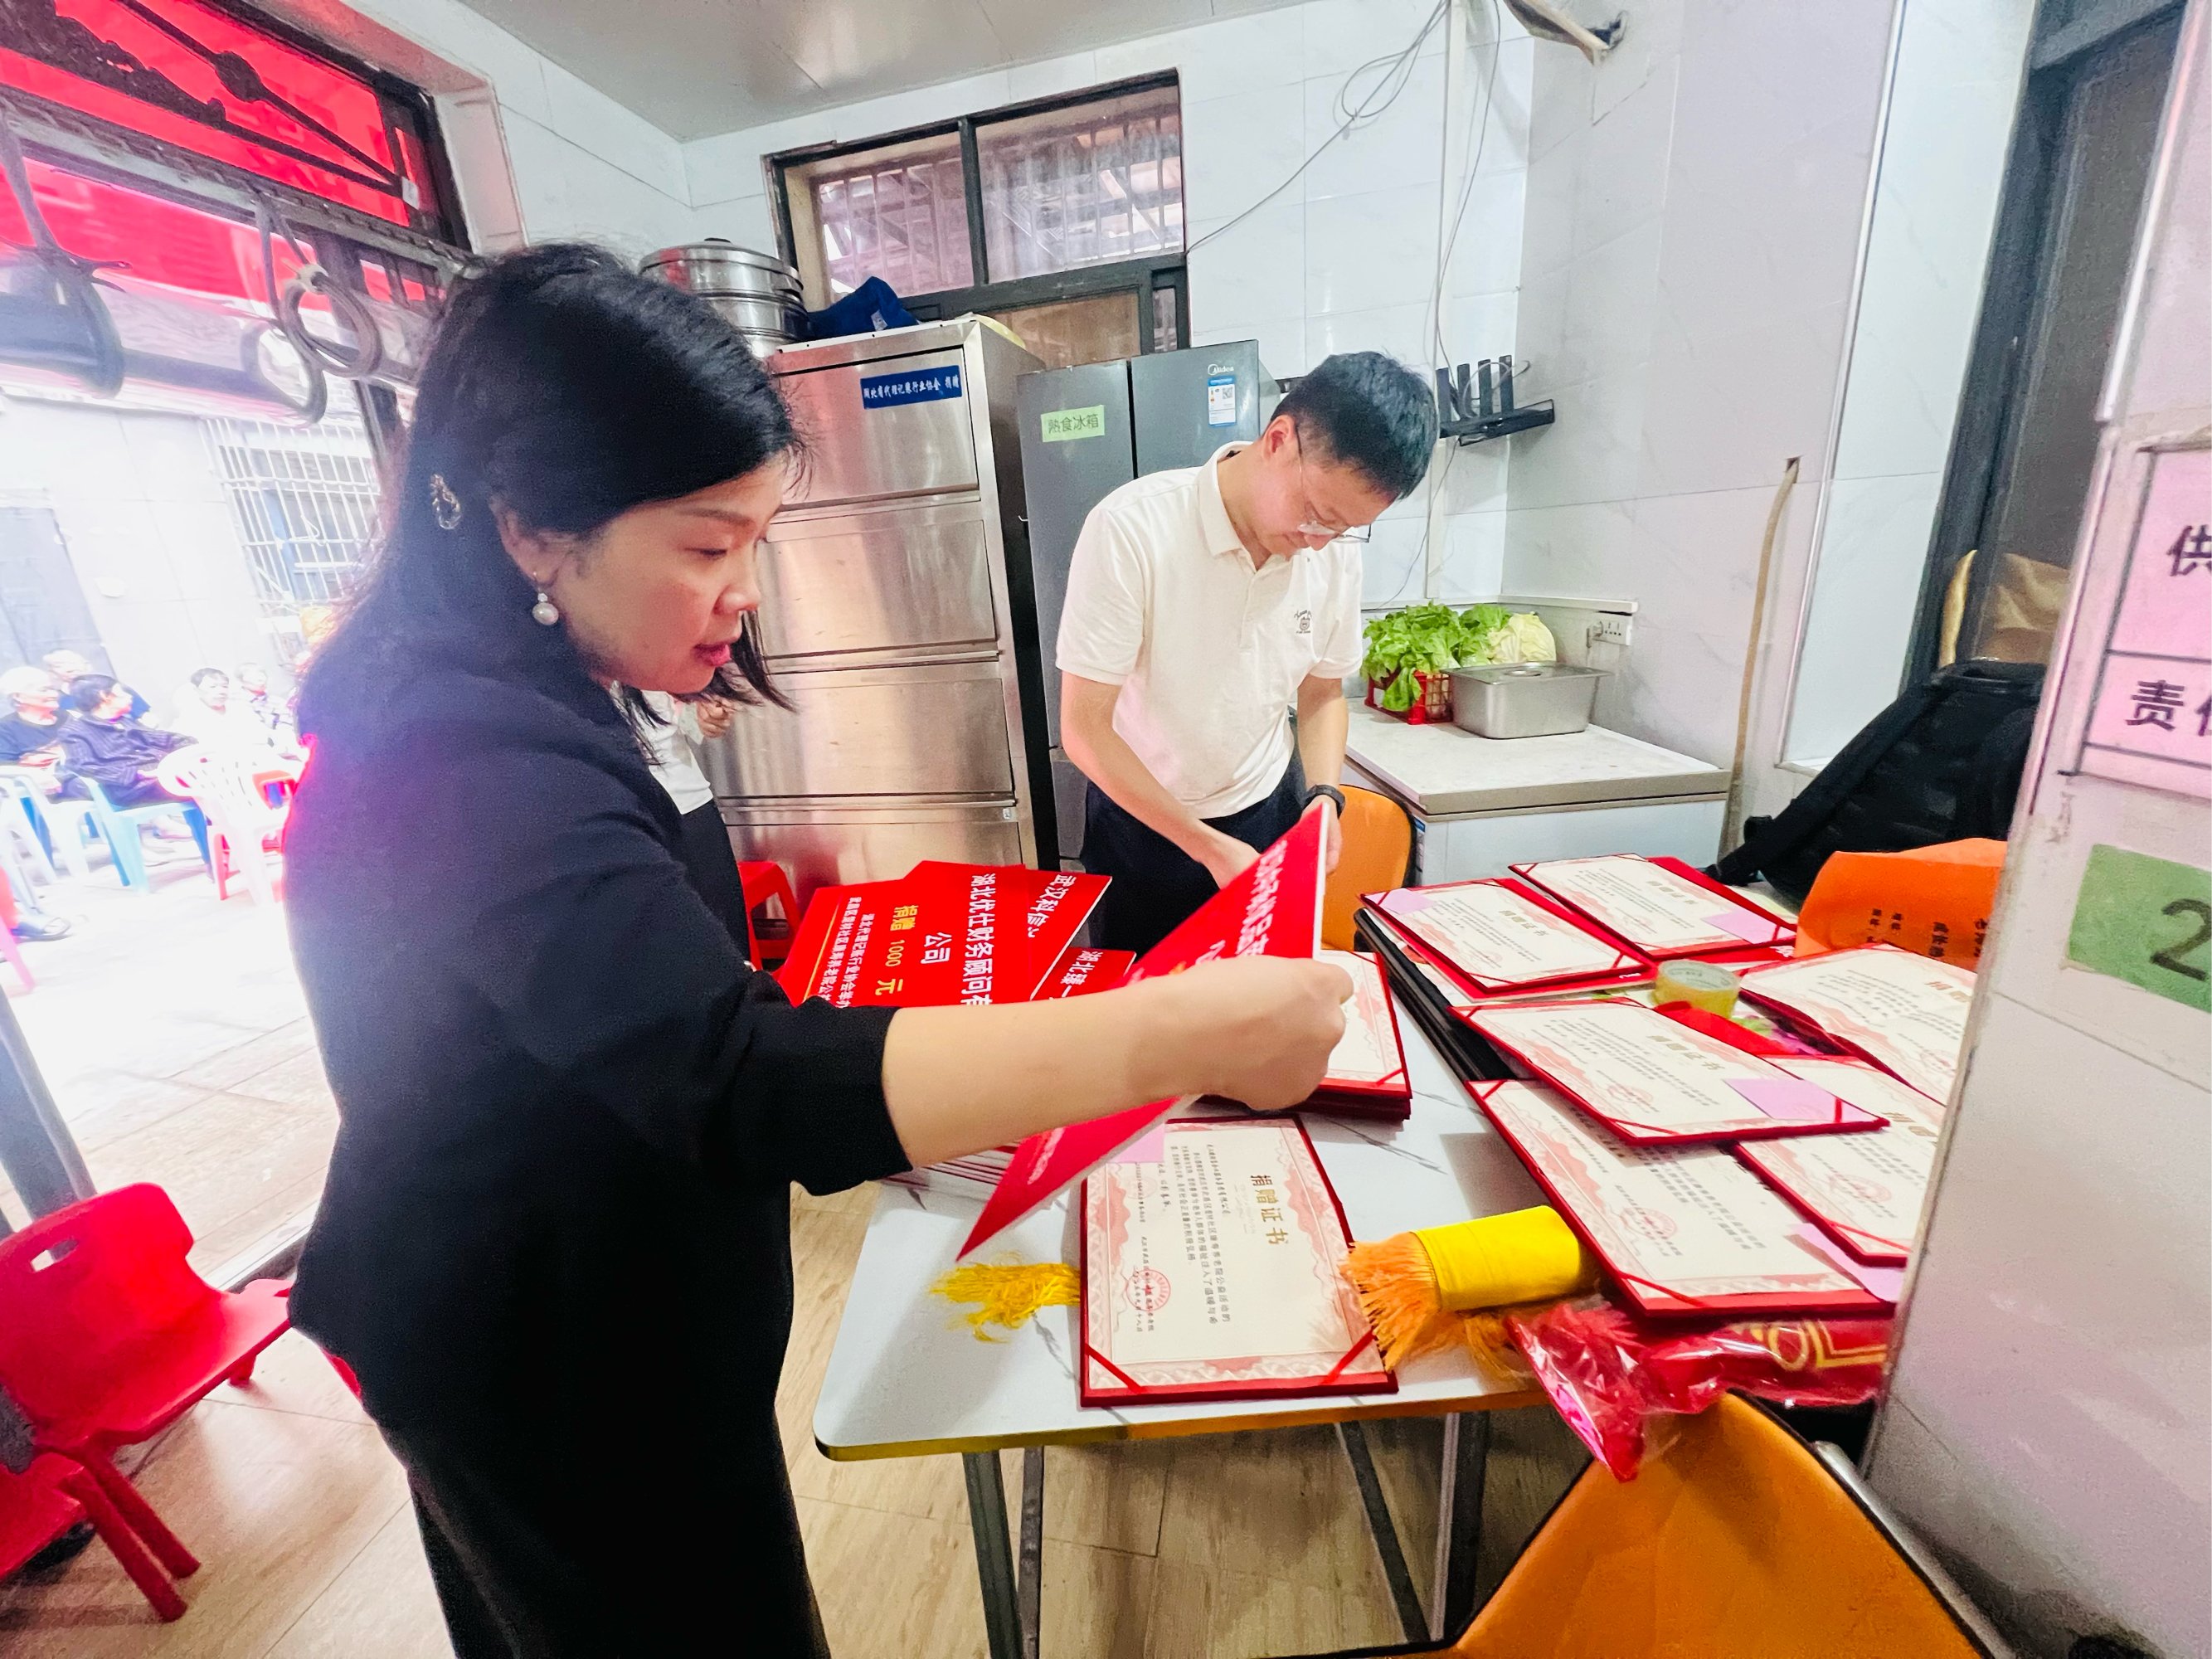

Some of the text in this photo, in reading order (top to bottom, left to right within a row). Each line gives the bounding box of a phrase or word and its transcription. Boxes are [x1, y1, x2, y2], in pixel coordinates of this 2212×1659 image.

[1048, 413, 1099, 434] 熟食冰箱
[960, 873, 997, 1006] 湖北优仕财务顾问有
[1027, 873, 1077, 939] 武汉科信
[2150, 898, 2212, 982] 2
[875, 904, 919, 996] 捐赠 1000 元
[921, 932, 953, 965] 公司
[1251, 1175, 1289, 1244] 捐赠证书
